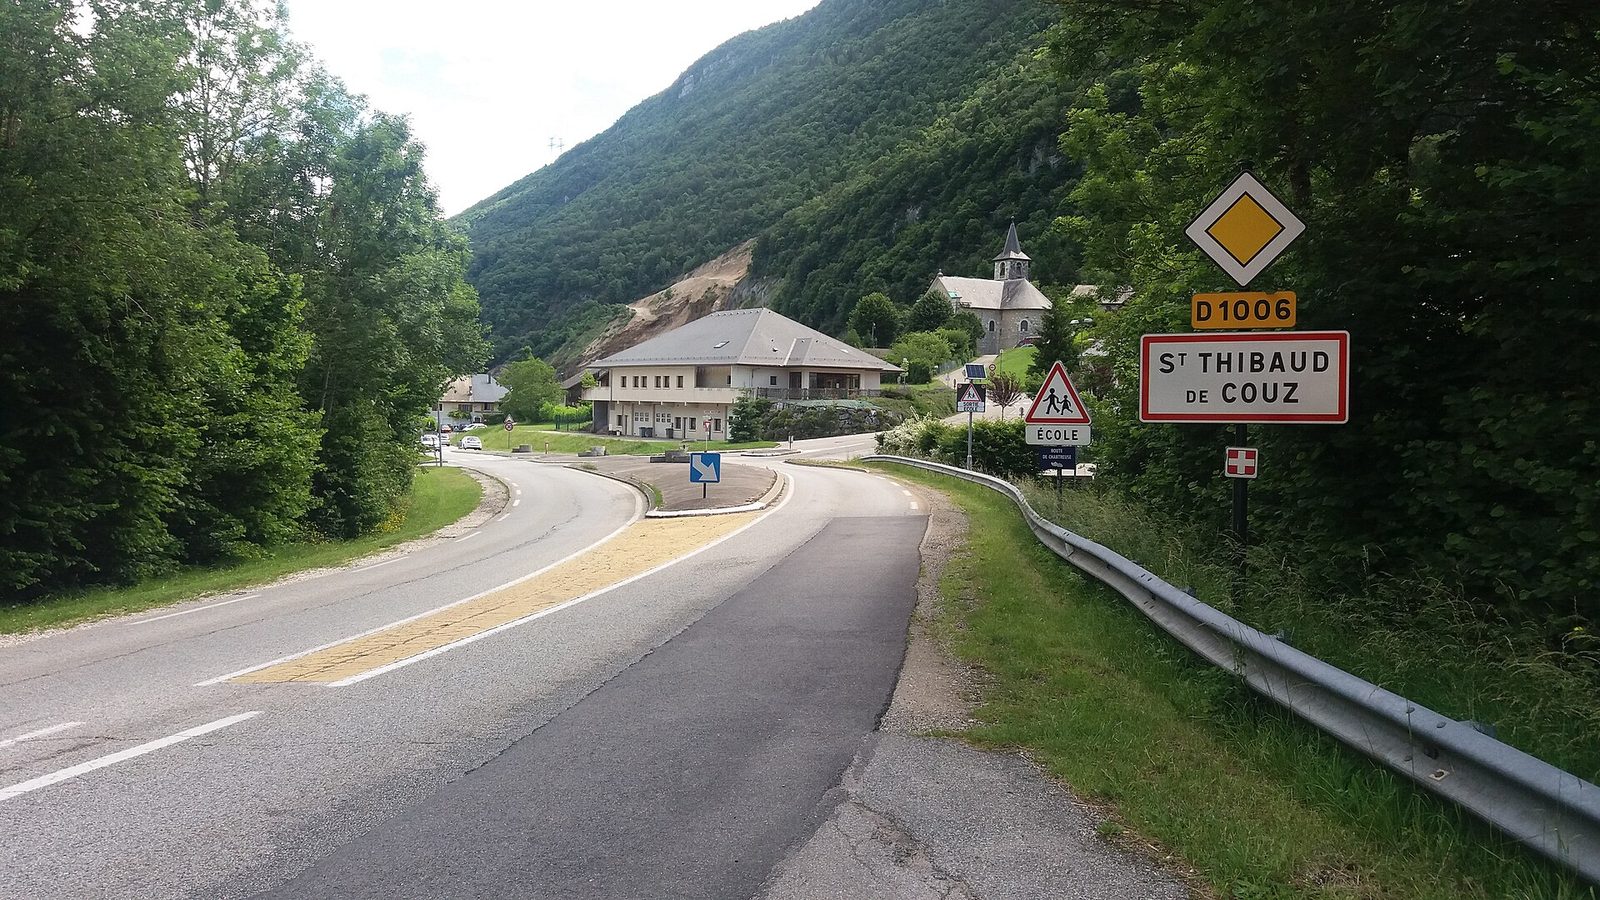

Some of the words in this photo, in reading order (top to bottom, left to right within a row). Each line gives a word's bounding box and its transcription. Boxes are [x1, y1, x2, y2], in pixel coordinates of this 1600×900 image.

[1198, 351, 1329, 373] THIBAUD
[1186, 390, 1208, 403] DE
[1221, 382, 1299, 404] COUZ
[1037, 427, 1078, 440] ÉCOLE
